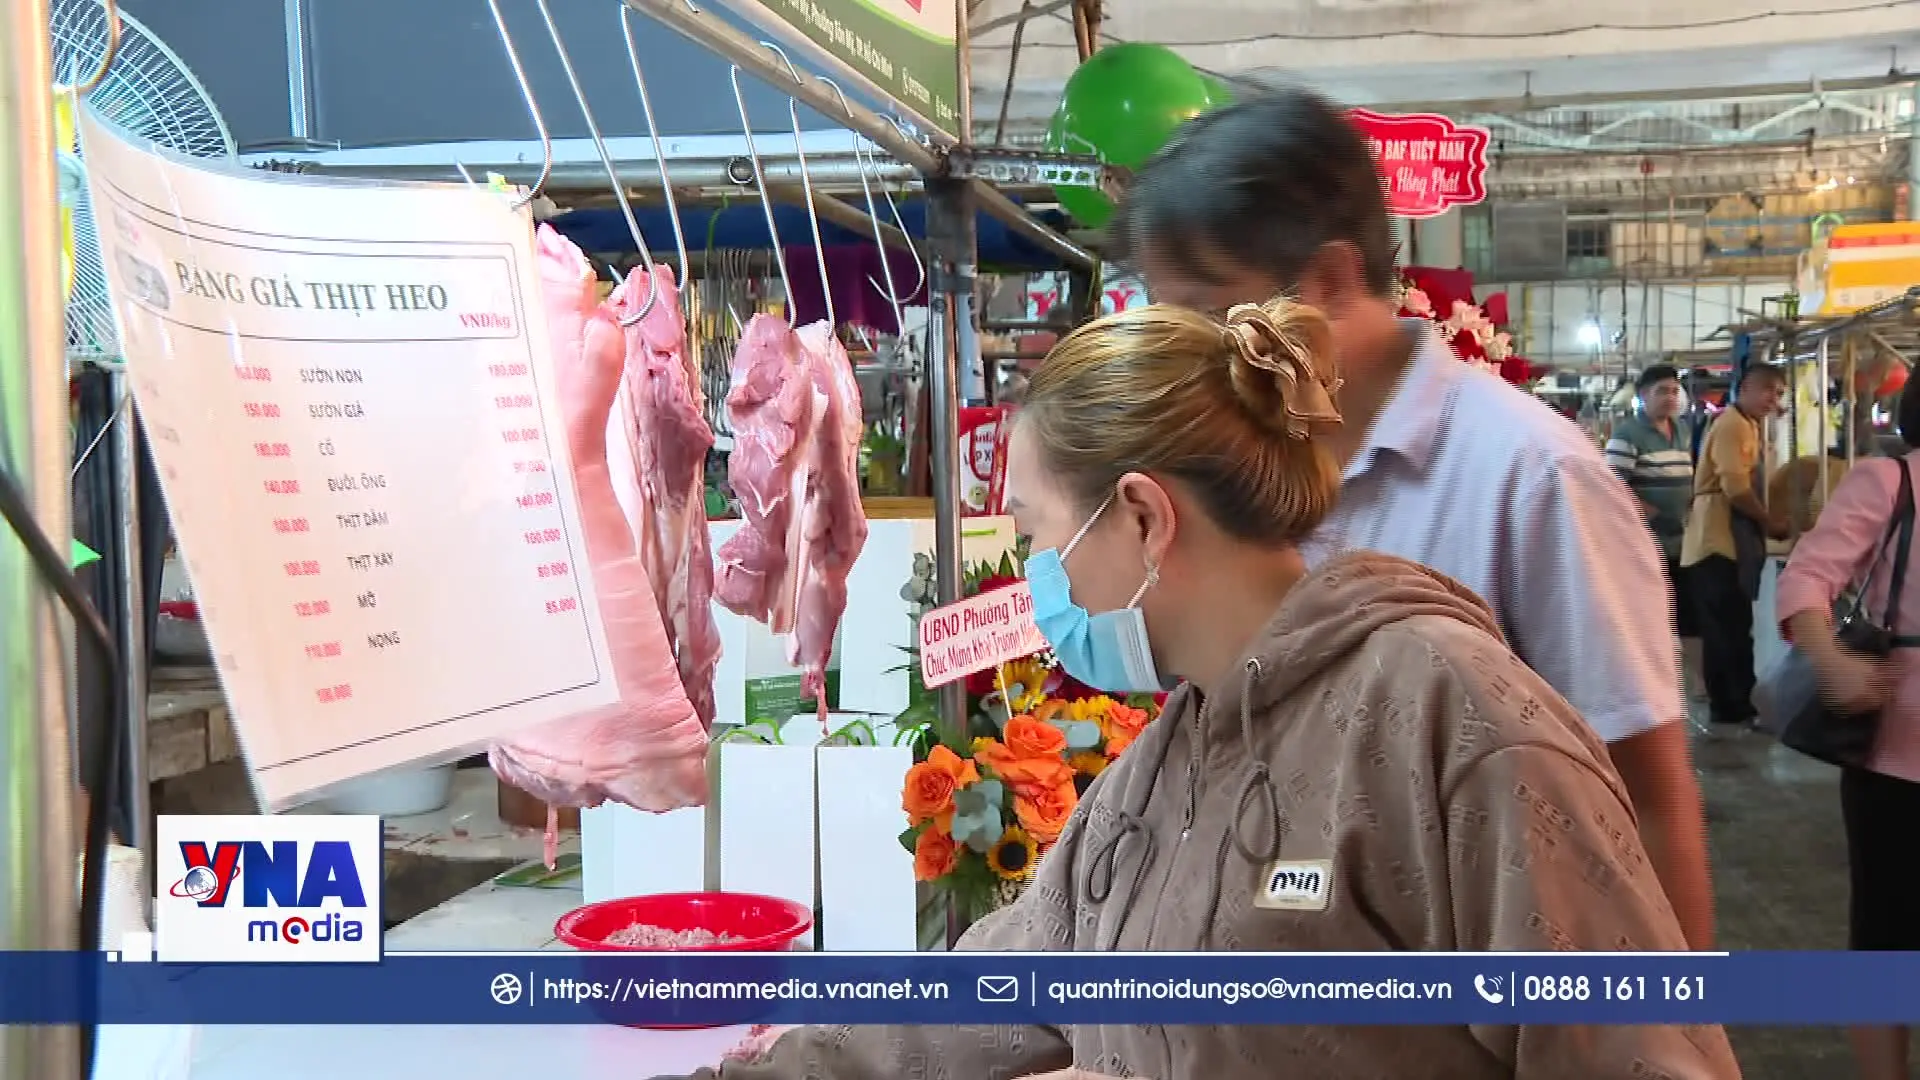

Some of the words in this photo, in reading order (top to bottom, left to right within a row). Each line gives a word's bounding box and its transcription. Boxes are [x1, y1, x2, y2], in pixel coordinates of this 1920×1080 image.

[1385, 141, 1406, 161] BAF
[1409, 137, 1436, 164] VIỆT
[1439, 140, 1465, 161] NAM
[175, 254, 245, 304] BẢNG
[304, 282, 377, 318] THỊT
[386, 285, 448, 312] HEO
[336, 368, 364, 384] NON
[345, 553, 371, 573] THỊT
[372, 552, 394, 568] XAY
[924, 611, 960, 646] UBND
[963, 600, 1010, 632] Phường
